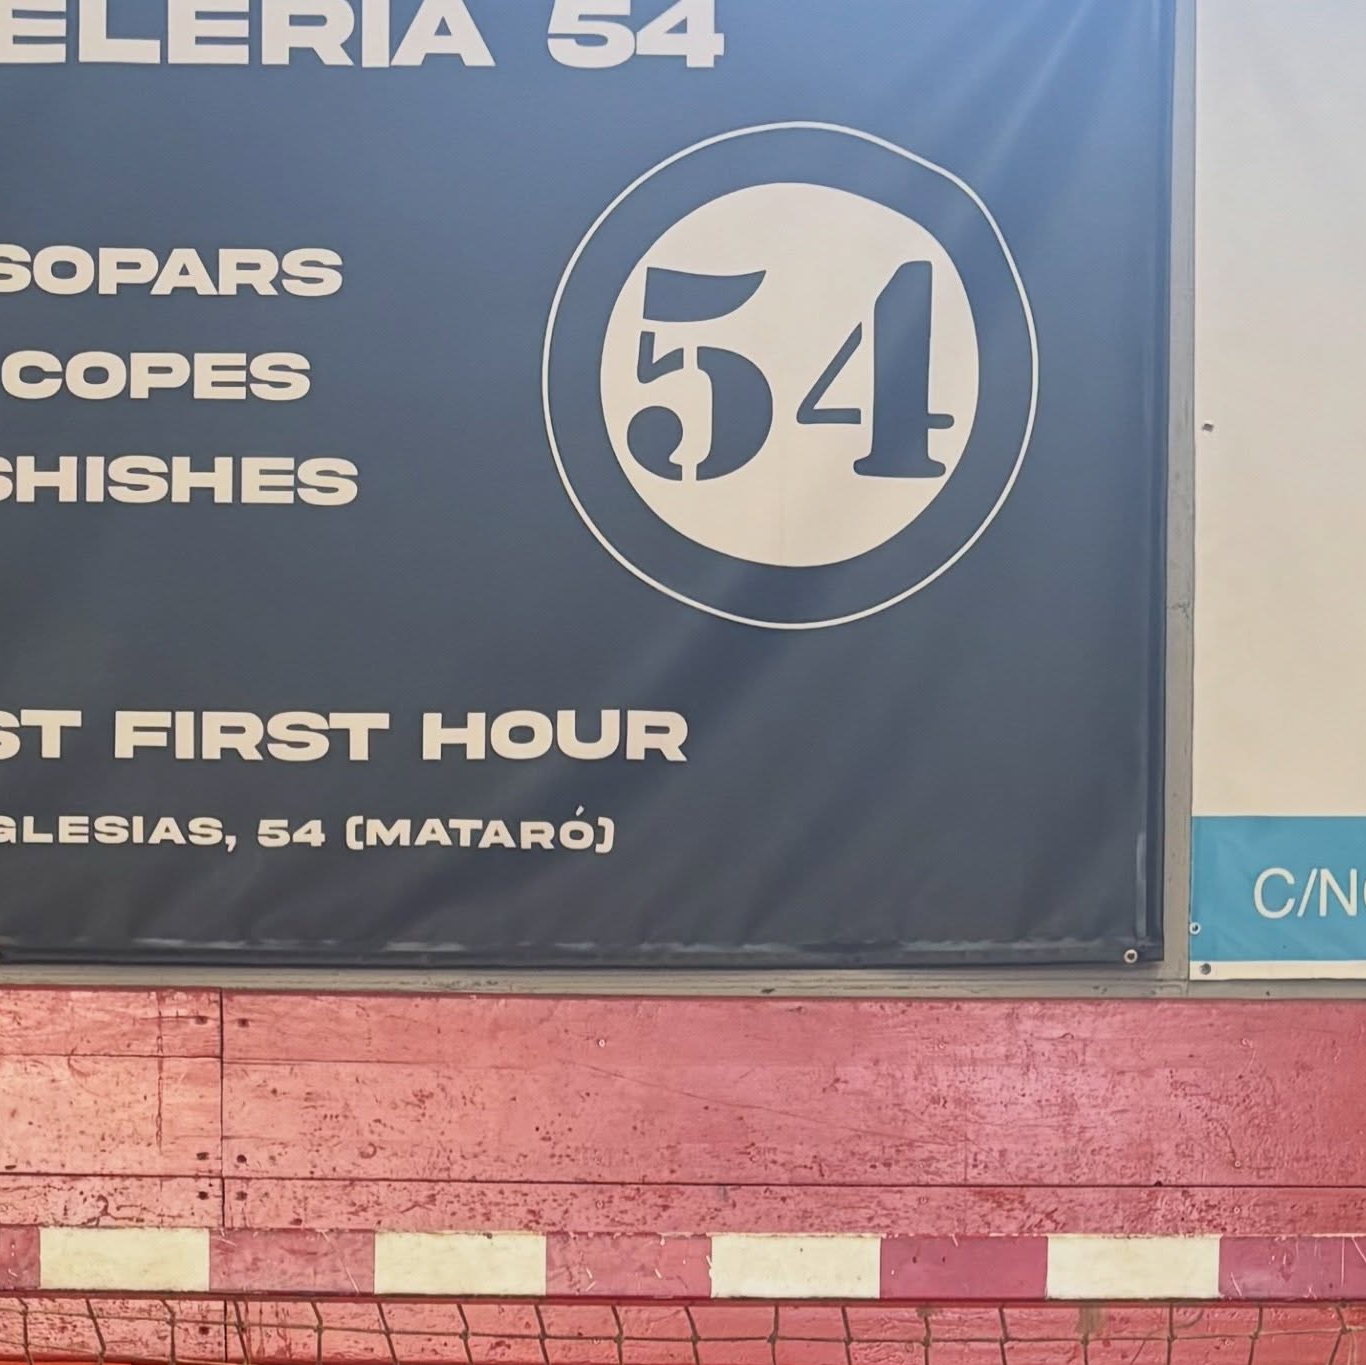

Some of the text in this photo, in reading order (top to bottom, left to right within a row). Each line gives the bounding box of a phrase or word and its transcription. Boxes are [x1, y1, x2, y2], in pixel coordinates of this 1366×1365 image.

[547, 0, 725, 68] 54
[2, 351, 311, 401] COPES
[626, 260, 955, 483] 54
[115, 711, 390, 762] FIRST
[423, 710, 688, 762] HOUR
[258, 820, 326, 848] 54
[346, 806, 615, 853] (MATARÓ)
